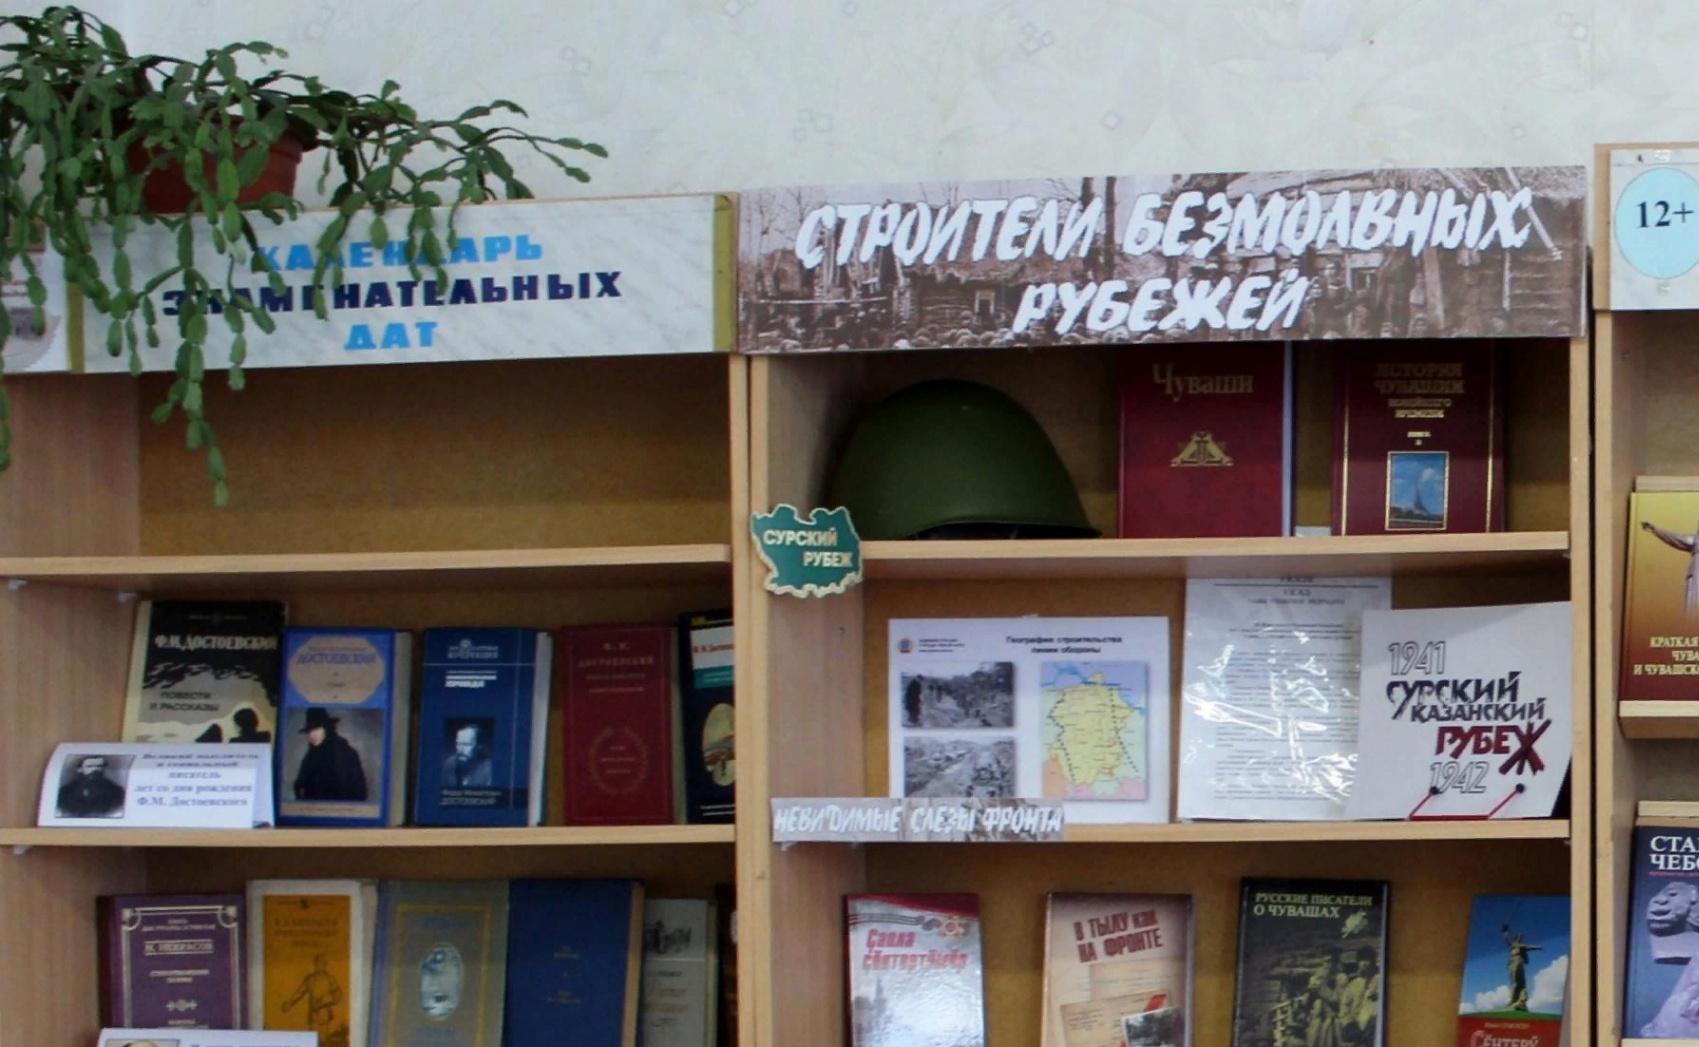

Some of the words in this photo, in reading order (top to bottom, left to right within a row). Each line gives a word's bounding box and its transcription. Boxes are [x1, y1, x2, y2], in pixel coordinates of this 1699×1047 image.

[798, 196, 1105, 268] СТРОИТЕЛИ
[1123, 187, 1533, 256] БЕЗМОЛВНЫХ
[1636, 201, 1694, 229] 12+
[1013, 270, 1309, 333] РУБЕЖЕЙ
[344, 322, 438, 350] ДАТ
[1152, 362, 1254, 401] Чуваши
[763, 527, 837, 546] СУРСКИЙ
[803, 551, 853, 567] РУБЕЖ
[1649, 636, 1698, 648] КРАТКАЯ
[1387, 641, 1446, 675] 1941
[1386, 671, 1521, 720] СУРСКИЙ
[1411, 697, 1545, 722] КАЗАНСКИЙ
[1435, 719, 1552, 775] РУБЕЖ
[1430, 760, 1488, 794] 1942
[774, 804, 901, 832] НЕВИДИМЫЕ
[910, 806, 977, 832] СЛЕЗЫ
[981, 806, 1063, 832] ФРОНТА
[1253, 904, 1264, 916] О
[1269, 904, 1342, 919] ЧУВАШАХ
[1255, 893, 1309, 905] РУССКИЕ
[1312, 894, 1374, 907] ПИСАТЕЛИ
[1073, 921, 1084, 941] В
[1089, 914, 1131, 940] ТЫЛУ
[1078, 943, 1098, 964] НА
[1104, 928, 1164, 958] ФРОНТЕ
